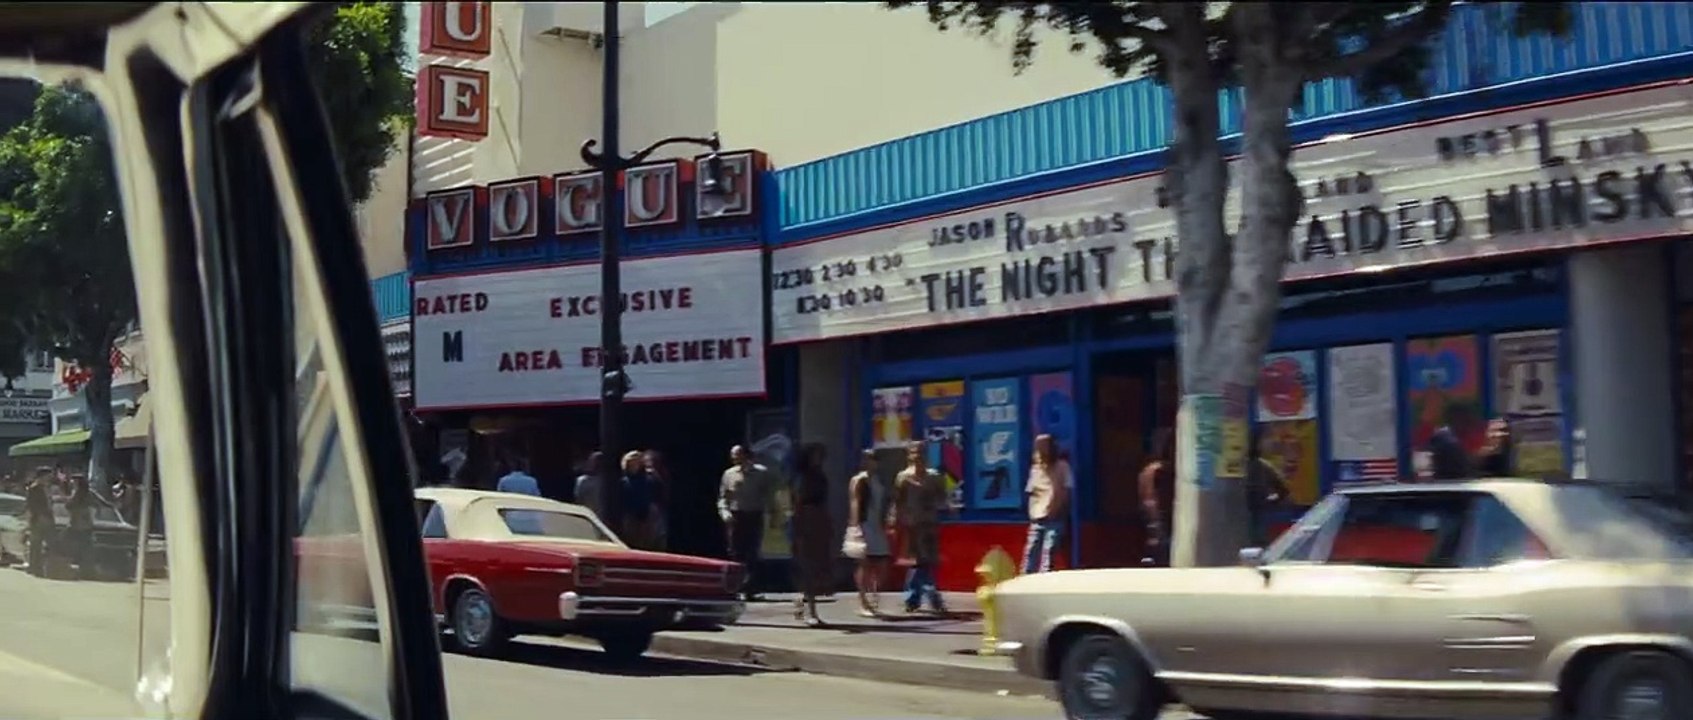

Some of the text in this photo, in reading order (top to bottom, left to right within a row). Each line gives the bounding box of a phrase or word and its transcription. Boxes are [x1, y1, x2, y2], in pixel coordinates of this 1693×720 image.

[431, 160, 744, 243] VOGUE
[928, 218, 995, 248] JASON
[1002, 246, 1116, 303] NIGHT
[416, 293, 488, 317] RATED
[442, 330, 464, 363] M
[499, 349, 562, 372] AREA
